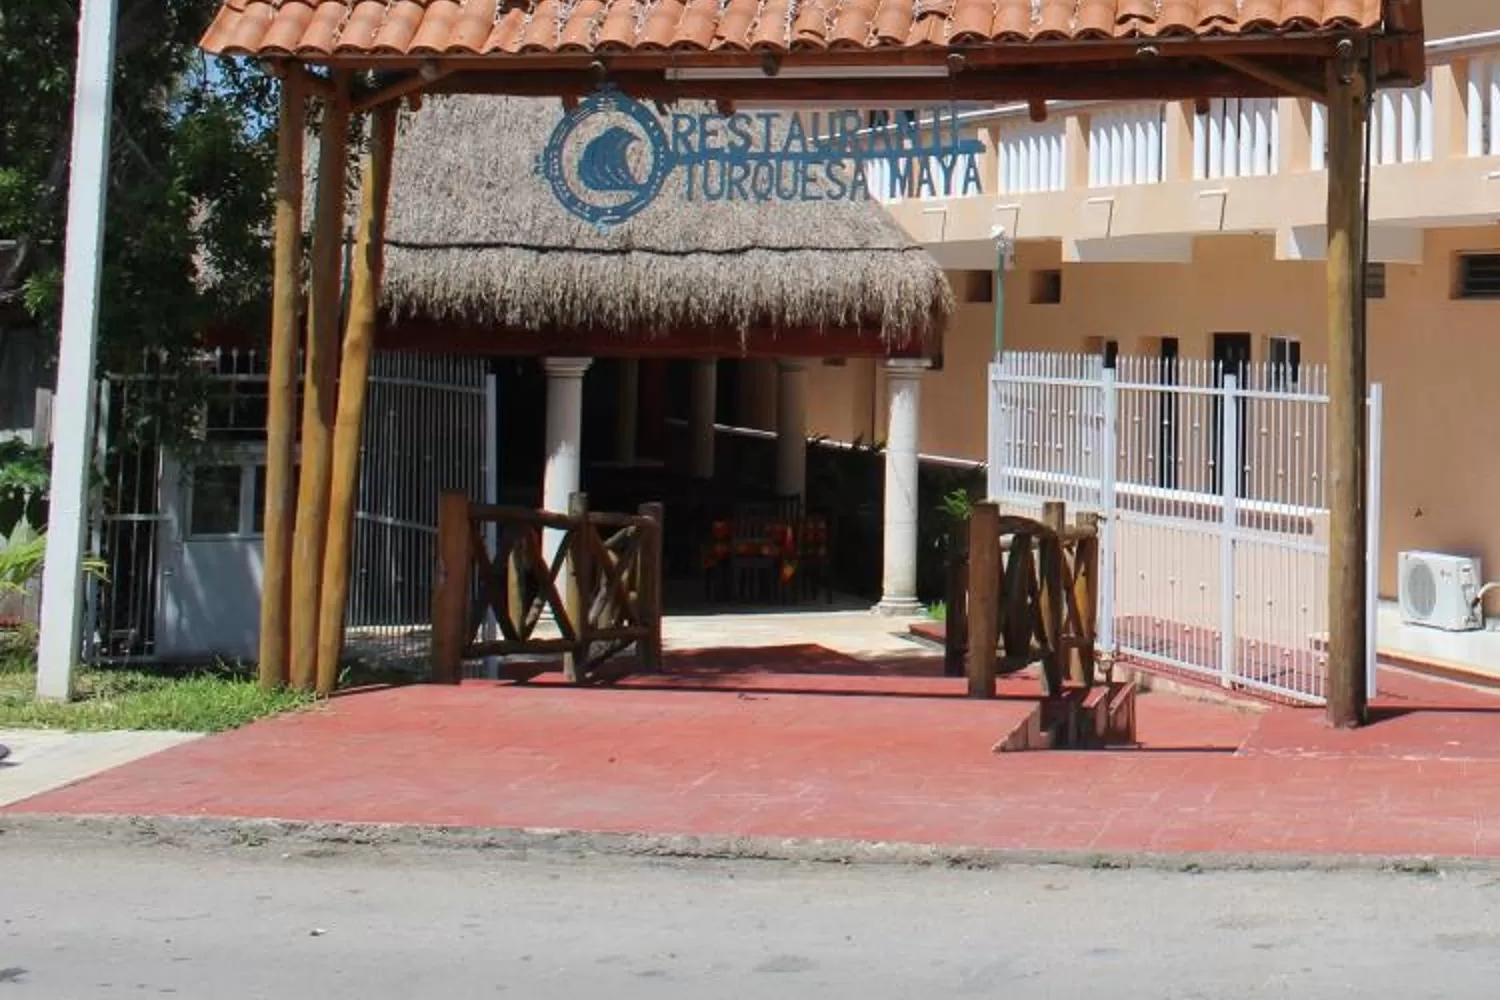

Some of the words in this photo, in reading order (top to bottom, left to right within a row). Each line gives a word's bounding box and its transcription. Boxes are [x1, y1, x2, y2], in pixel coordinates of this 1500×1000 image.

[671, 105, 973, 153] RESTAURANTE
[682, 154, 869, 201] TURQUESA
[889, 153, 983, 198] MAYA
